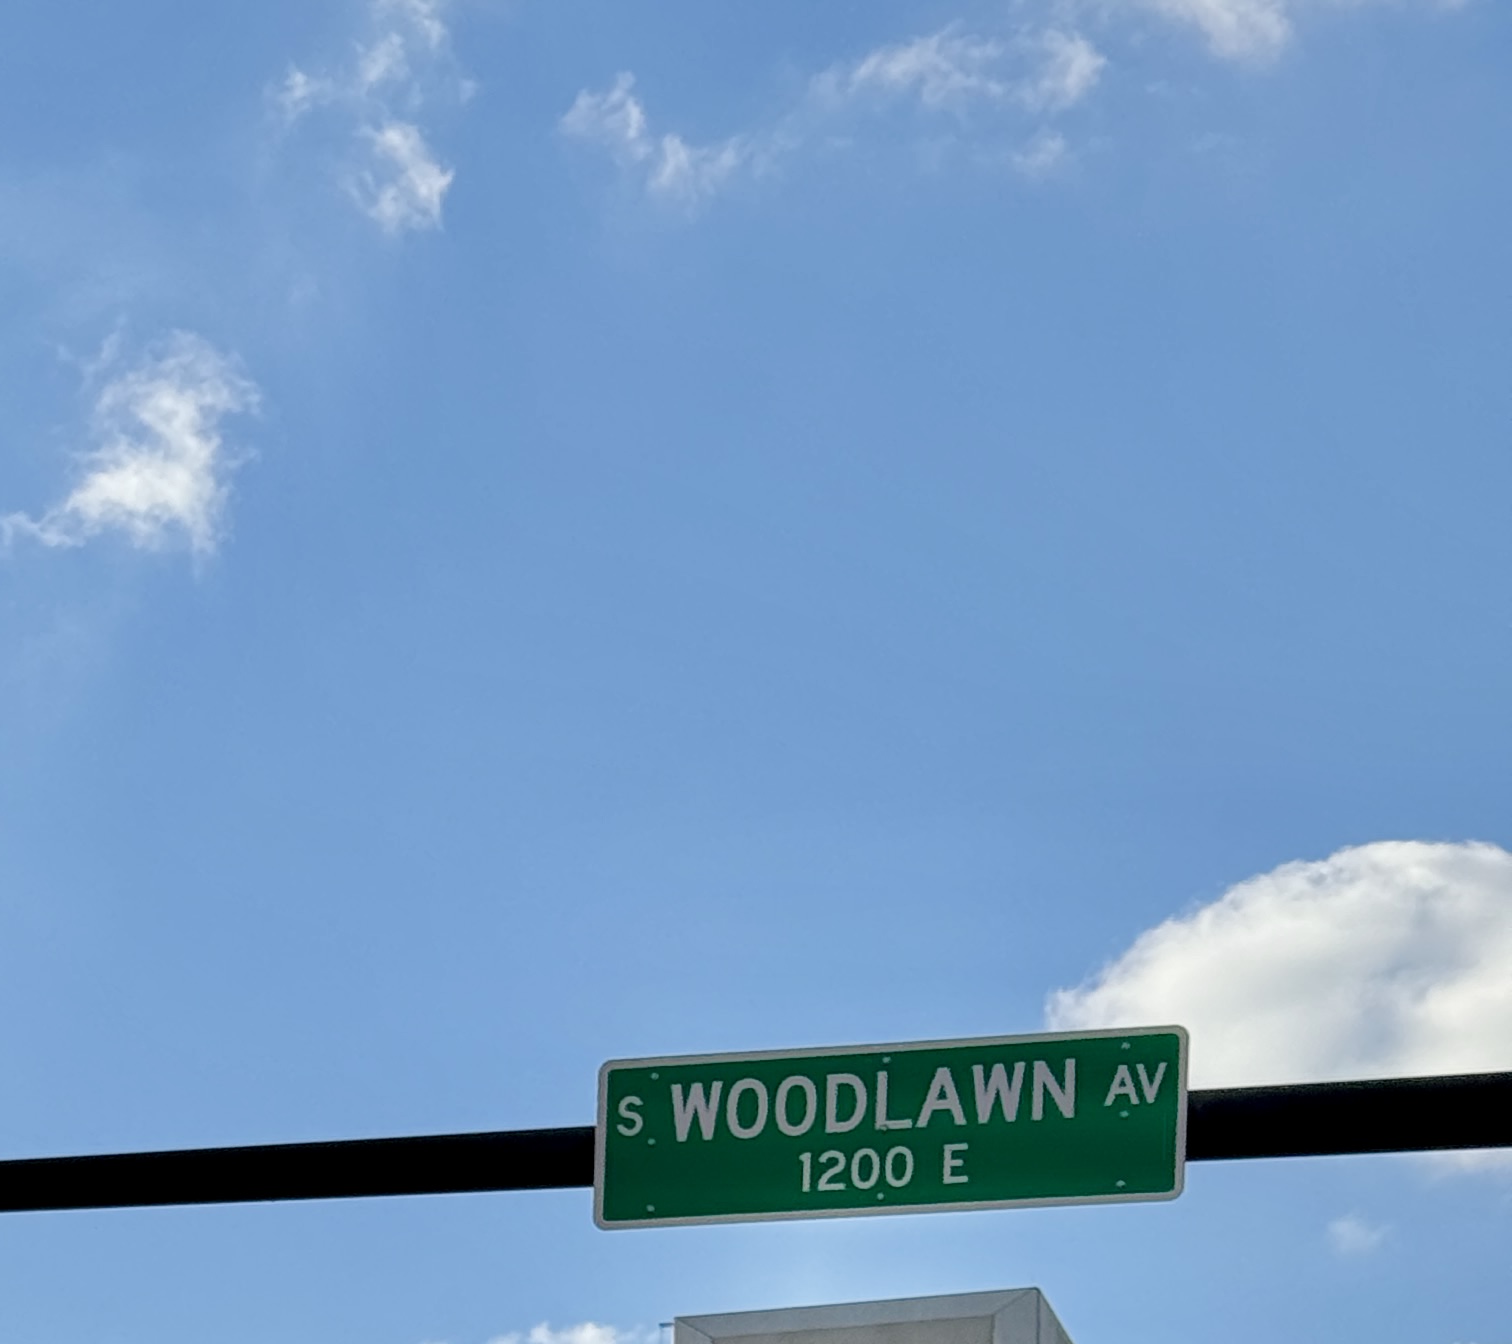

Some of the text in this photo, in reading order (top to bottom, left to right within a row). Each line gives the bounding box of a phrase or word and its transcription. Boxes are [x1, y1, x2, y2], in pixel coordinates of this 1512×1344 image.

[616, 1057, 1168, 1143] S WOODLAWN AV
[799, 1142, 969, 1193] 1200 E
